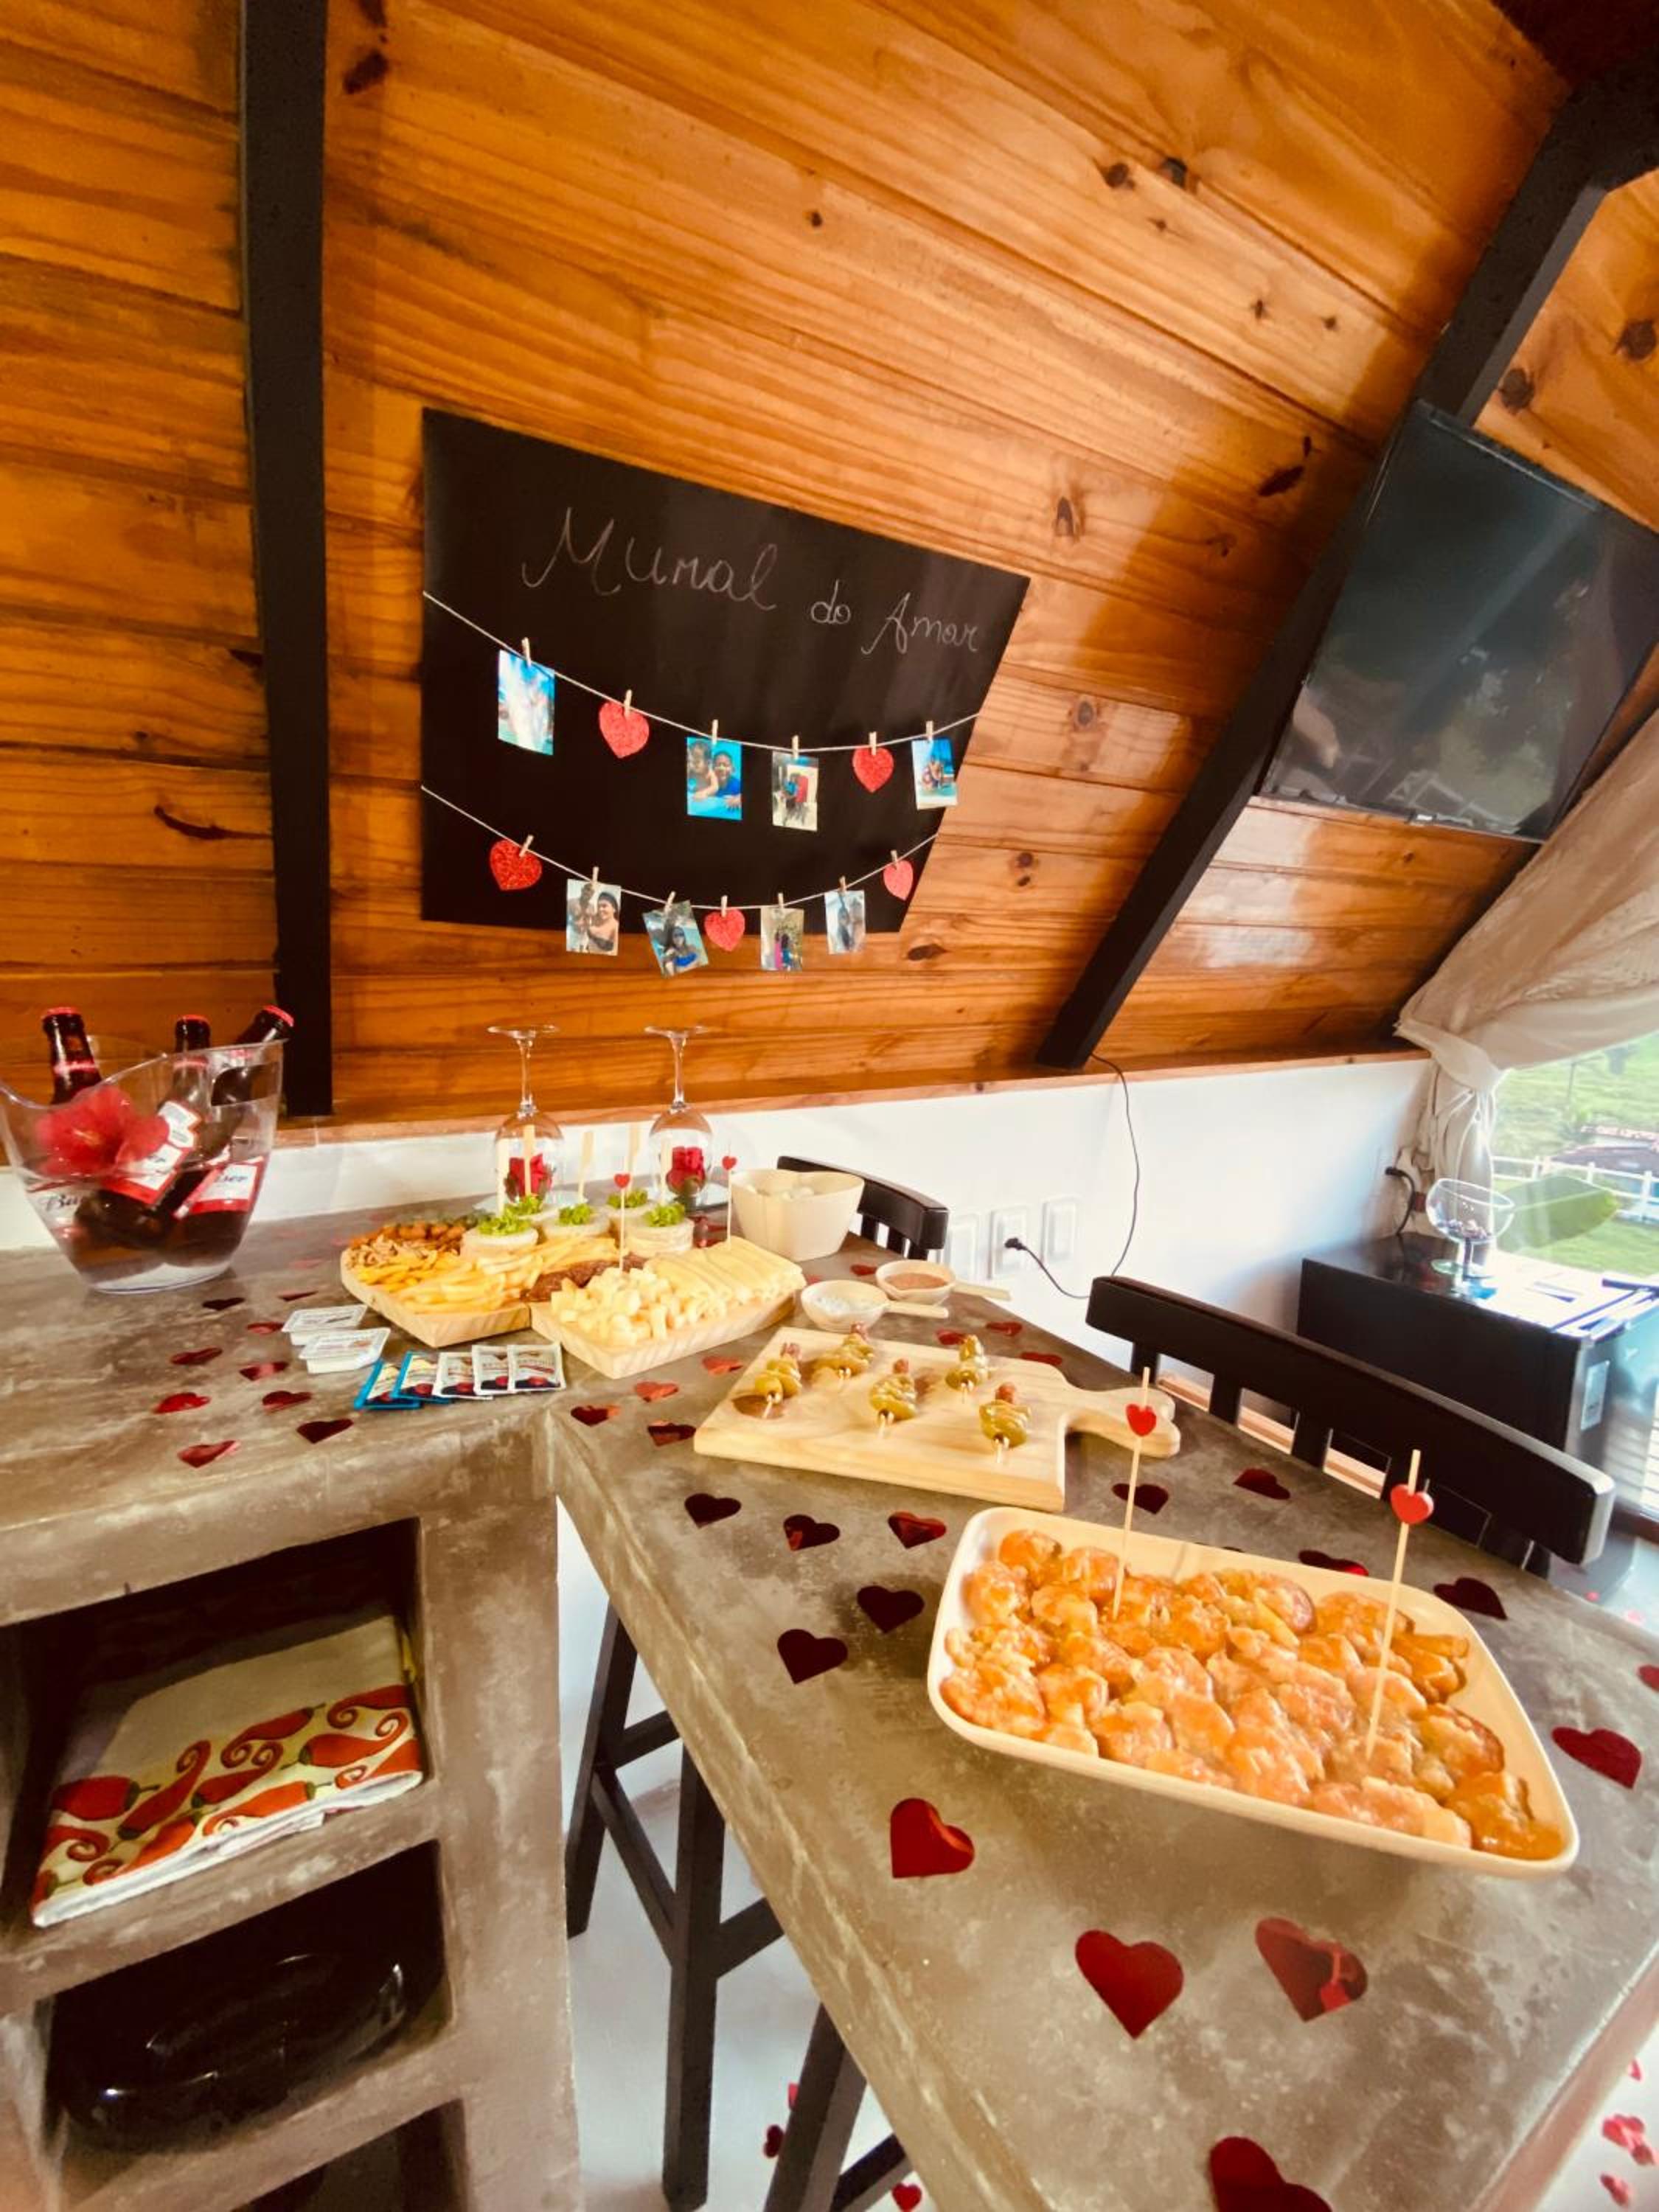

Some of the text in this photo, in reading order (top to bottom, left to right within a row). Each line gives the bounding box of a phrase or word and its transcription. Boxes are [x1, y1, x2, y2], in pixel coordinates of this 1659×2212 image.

[521, 506, 980, 655] Mural do Amor
